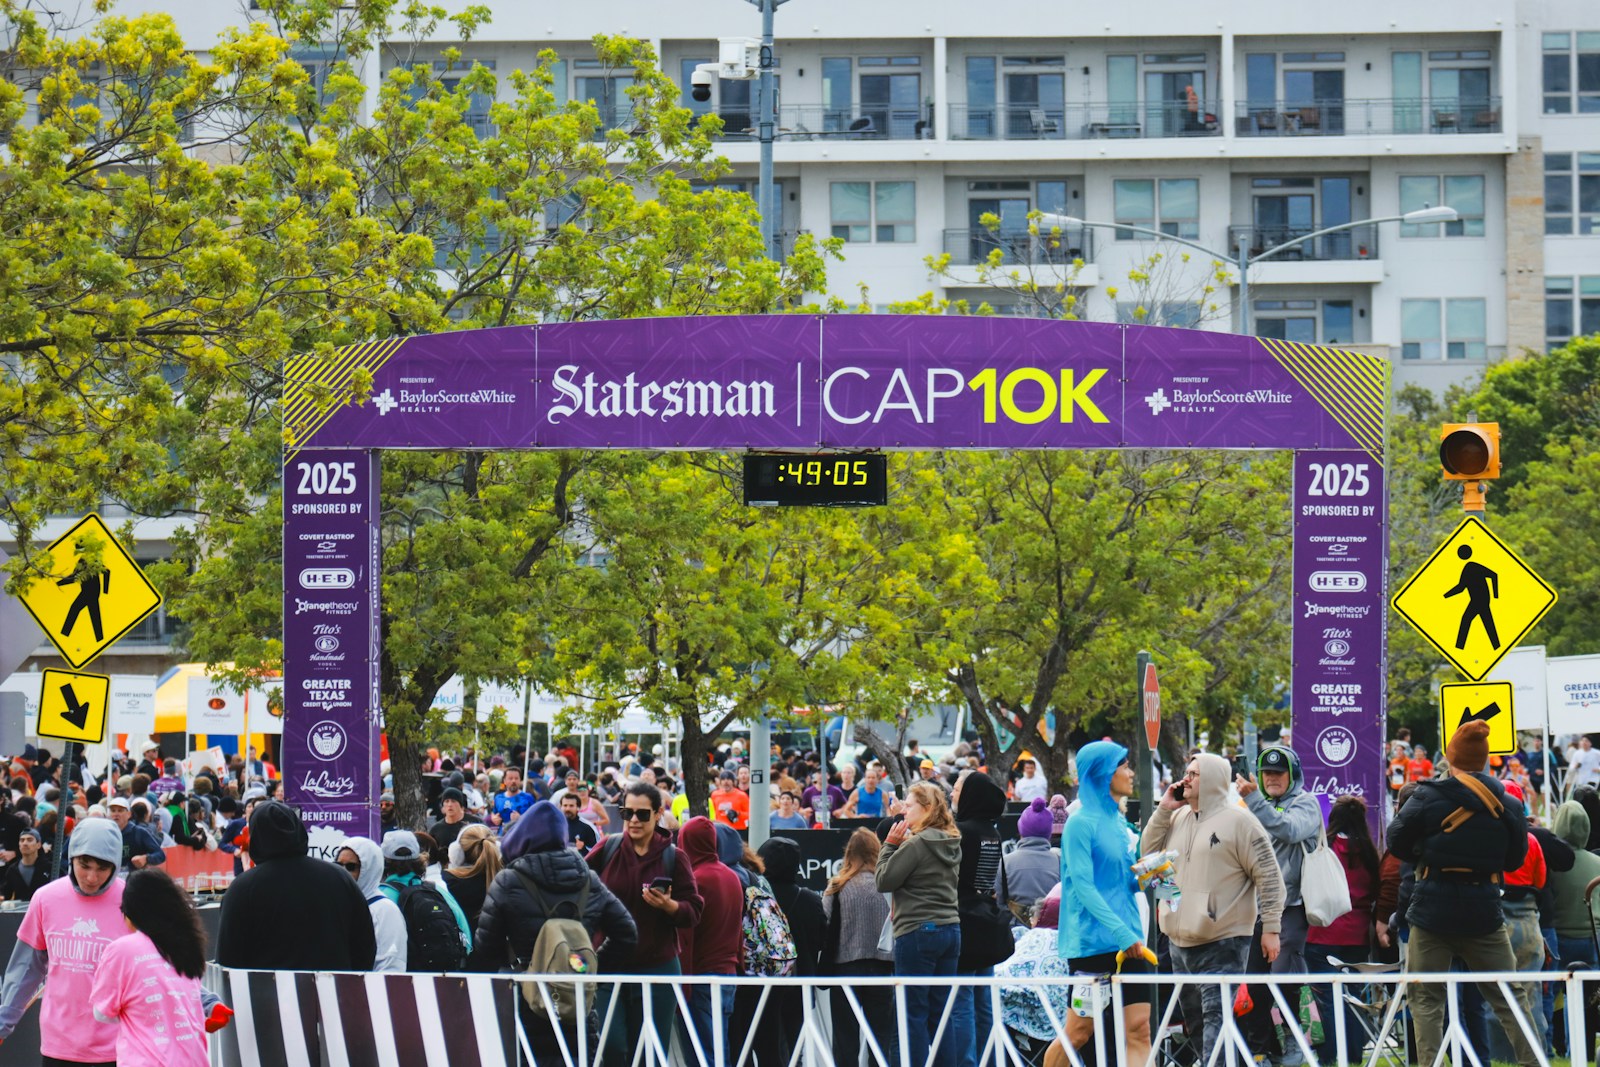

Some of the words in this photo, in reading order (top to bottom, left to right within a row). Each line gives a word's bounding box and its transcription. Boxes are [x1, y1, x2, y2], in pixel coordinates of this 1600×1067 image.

[399, 389, 516, 407] BaylorScott&White
[548, 365, 777, 424] Statesman
[823, 366, 1110, 425] CAP10K
[1173, 389, 1292, 406] BaylorScott&White
[297, 462, 357, 495] 2025
[1308, 463, 1370, 497] 2025
[292, 503, 347, 514] SPONSORED
[350, 503, 362, 514] BY
[1302, 505, 1359, 516] SPONSORED
[1362, 505, 1375, 516] BY
[313, 624, 341, 634] Tito's
[1322, 627, 1352, 639] Tito's
[309, 652, 345, 661] Handmade
[1318, 657, 1356, 666] Handmade
[302, 679, 351, 690] GREATER
[1311, 684, 1362, 694] GREATER
[309, 690, 346, 700] TEXAS
[485, 695, 518, 703] ULTRA
[1318, 695, 1356, 706] TEXAS
[1570, 692, 1599, 700] TEXAS
[1144, 691, 1160, 722] STOP
[317, 725, 337, 733] SIETE
[302, 811, 352, 821] BENEFITING
[50, 938, 108, 963] VOLUNTEE
